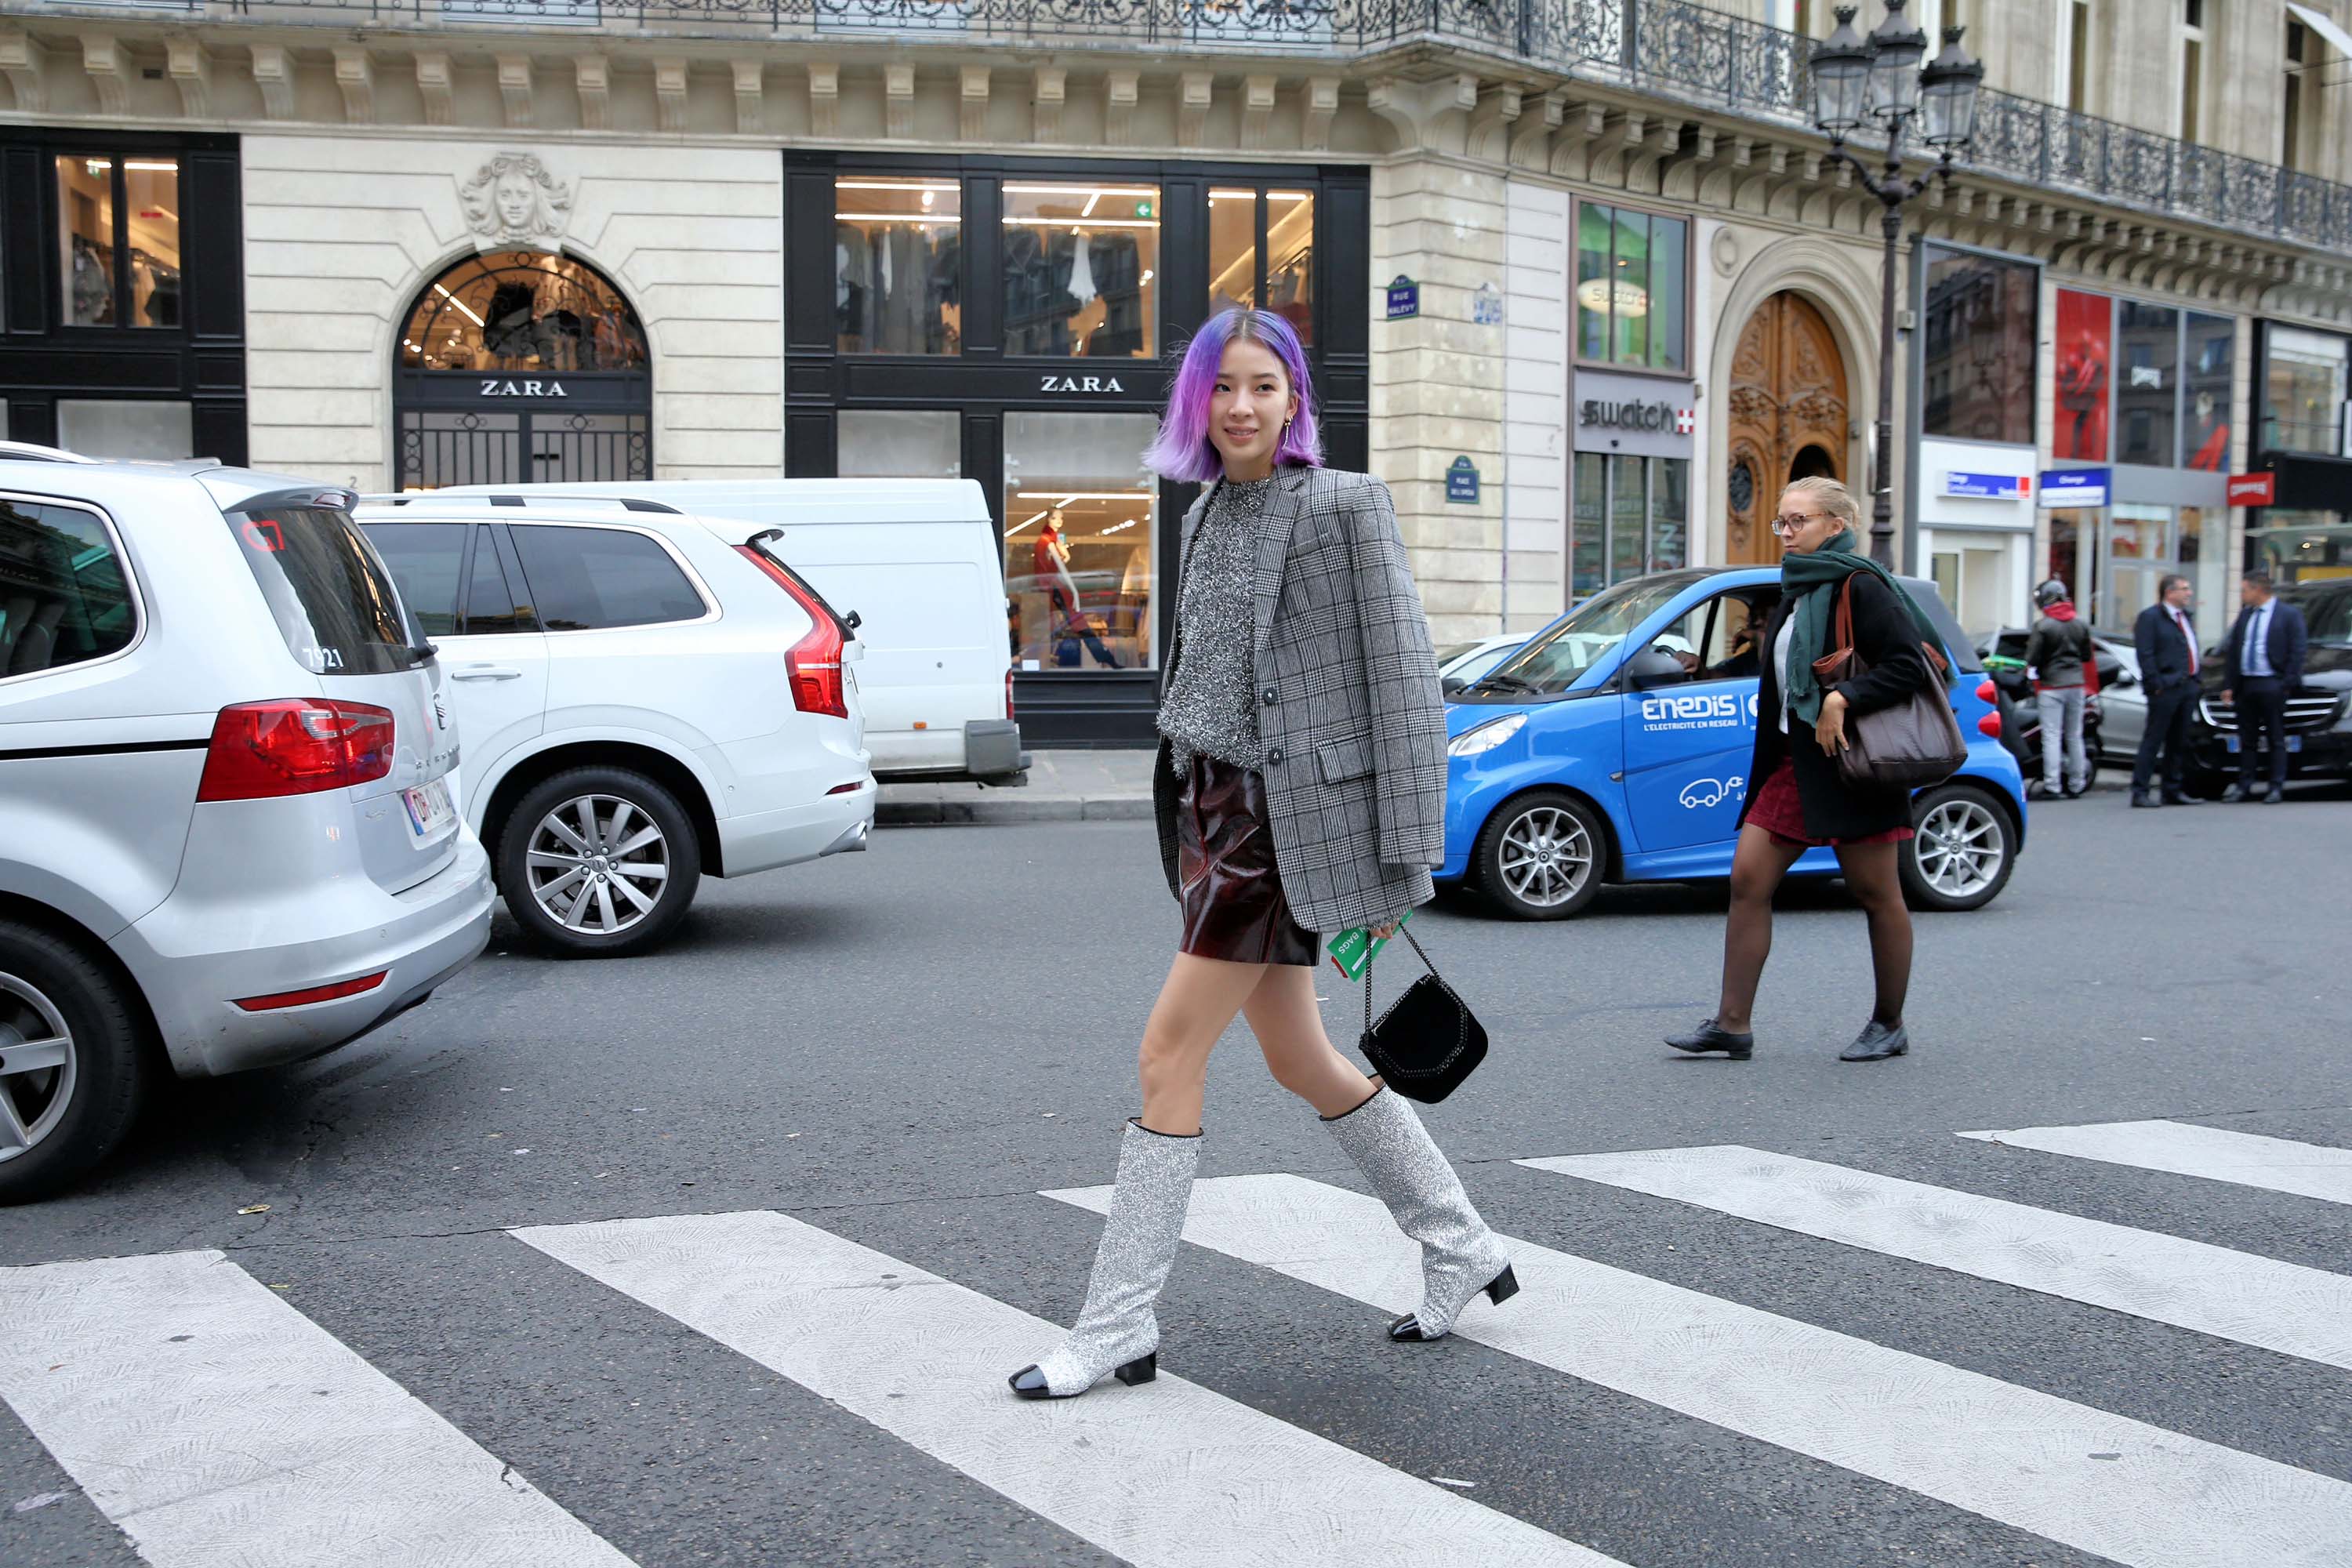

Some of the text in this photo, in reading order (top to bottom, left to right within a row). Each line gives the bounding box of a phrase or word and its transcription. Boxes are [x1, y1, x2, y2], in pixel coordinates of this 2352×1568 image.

[481, 379, 568, 396] ZARA
[1041, 376, 1124, 392] ZARA
[1580, 397, 1675, 432] swatch
[350, 476, 358, 488] 2
[241, 520, 286, 552] G7
[302, 648, 344, 668] 7921
[1697, 720, 1708, 729] EN
[1338, 932, 1359, 953] BAGS
